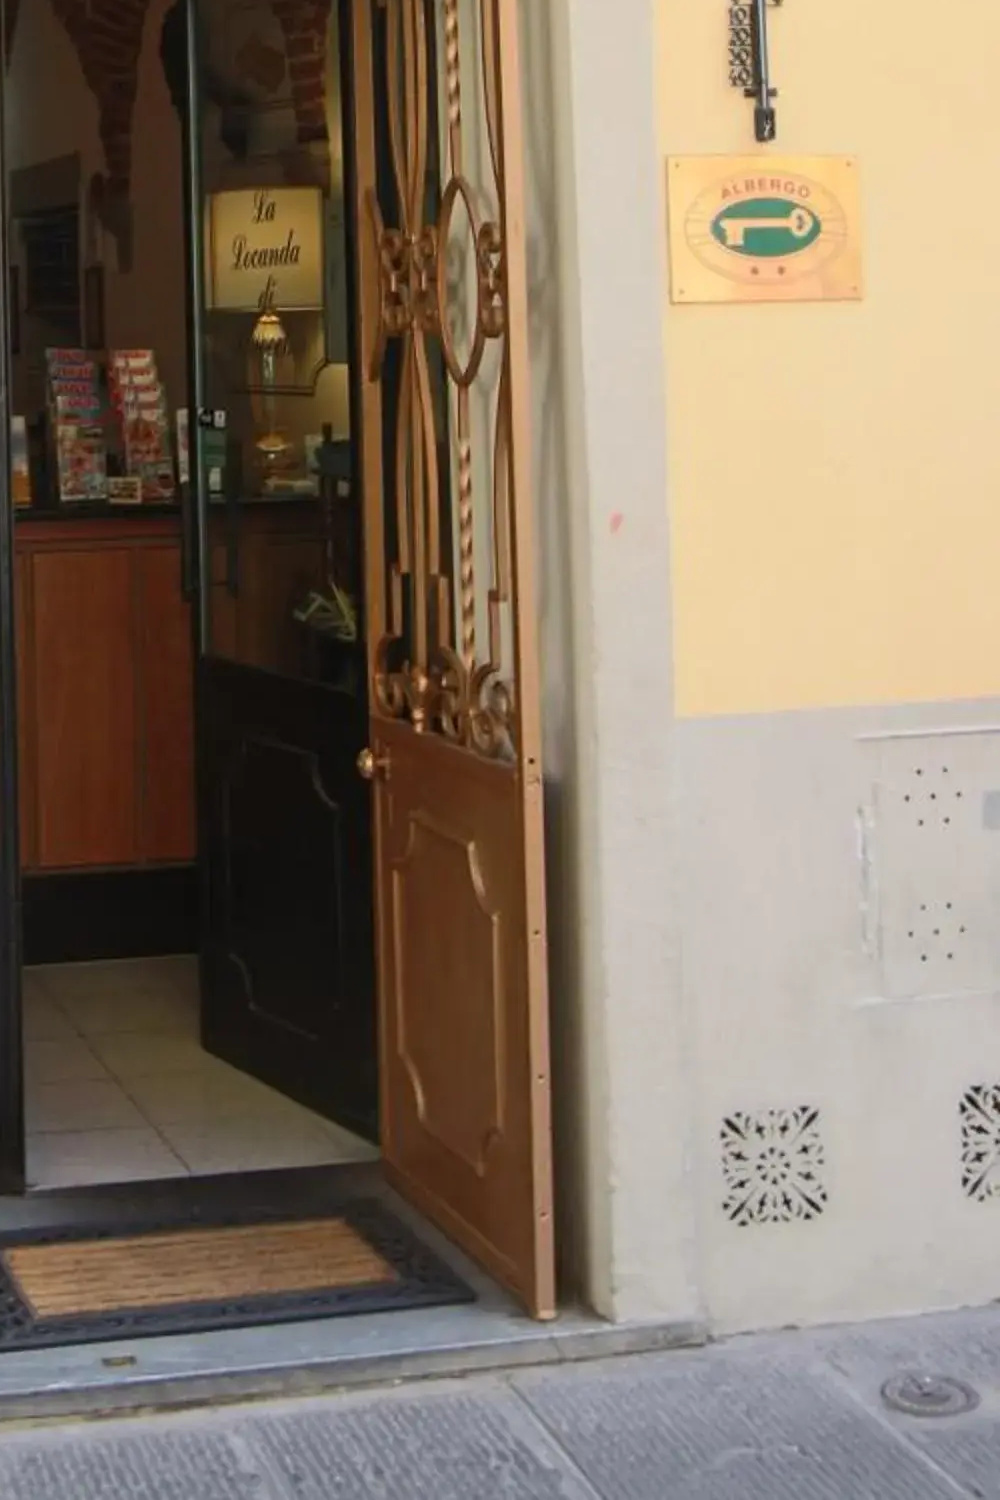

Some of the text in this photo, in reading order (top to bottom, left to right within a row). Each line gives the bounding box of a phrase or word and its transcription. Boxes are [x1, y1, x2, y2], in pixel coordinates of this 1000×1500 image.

[252, 188, 276, 224] La
[721, 178, 811, 199] ALBERGO
[231, 228, 301, 270] Locanda
